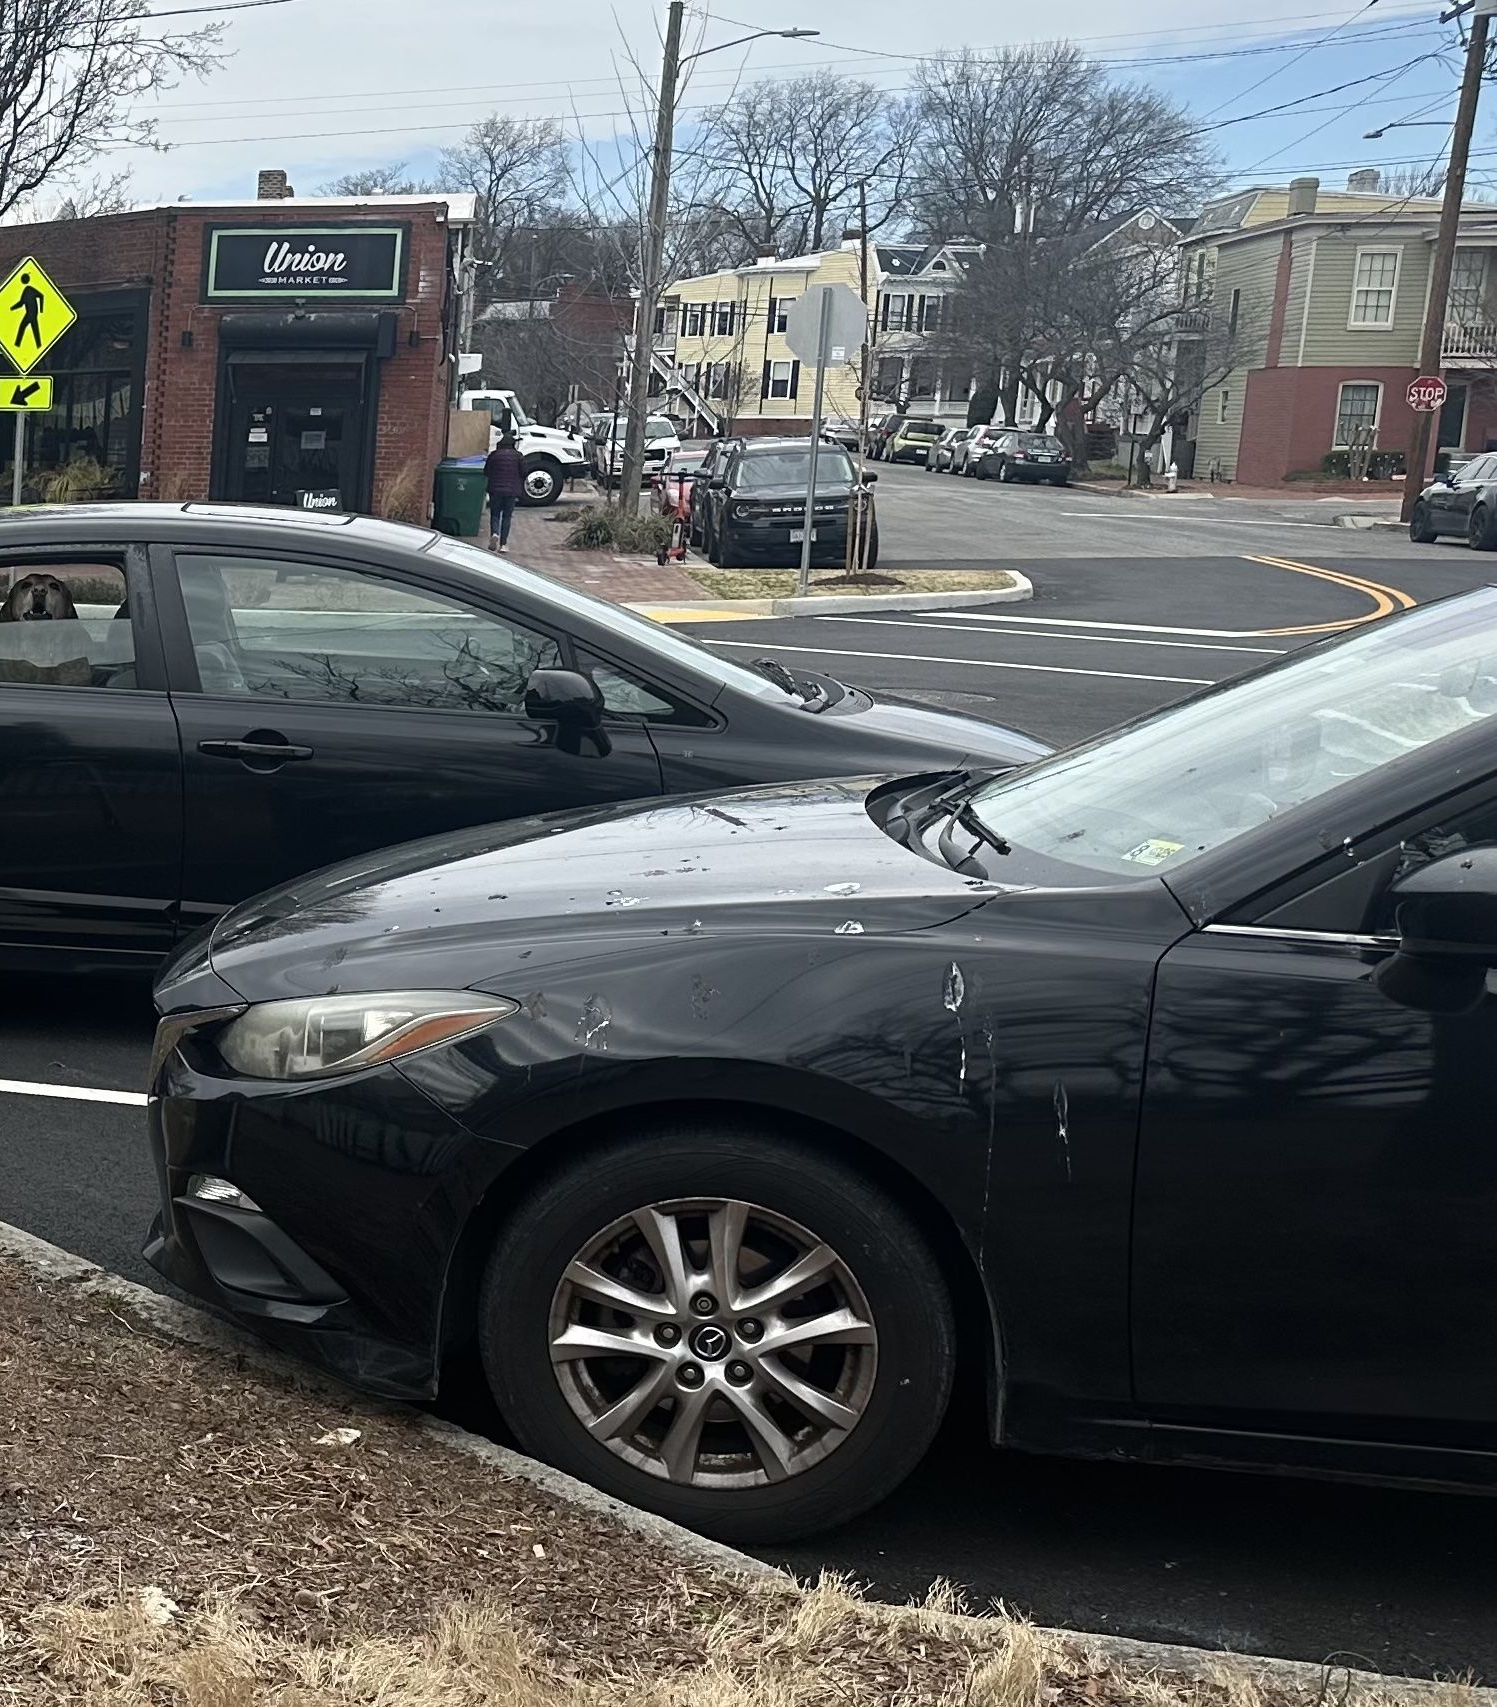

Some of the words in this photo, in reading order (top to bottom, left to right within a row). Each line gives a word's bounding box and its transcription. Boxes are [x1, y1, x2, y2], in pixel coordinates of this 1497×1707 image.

[264, 241, 347, 273] Union
[278, 276, 328, 284] MARKET
[1409, 387, 1443, 401] STOP
[303, 492, 338, 508] Union
